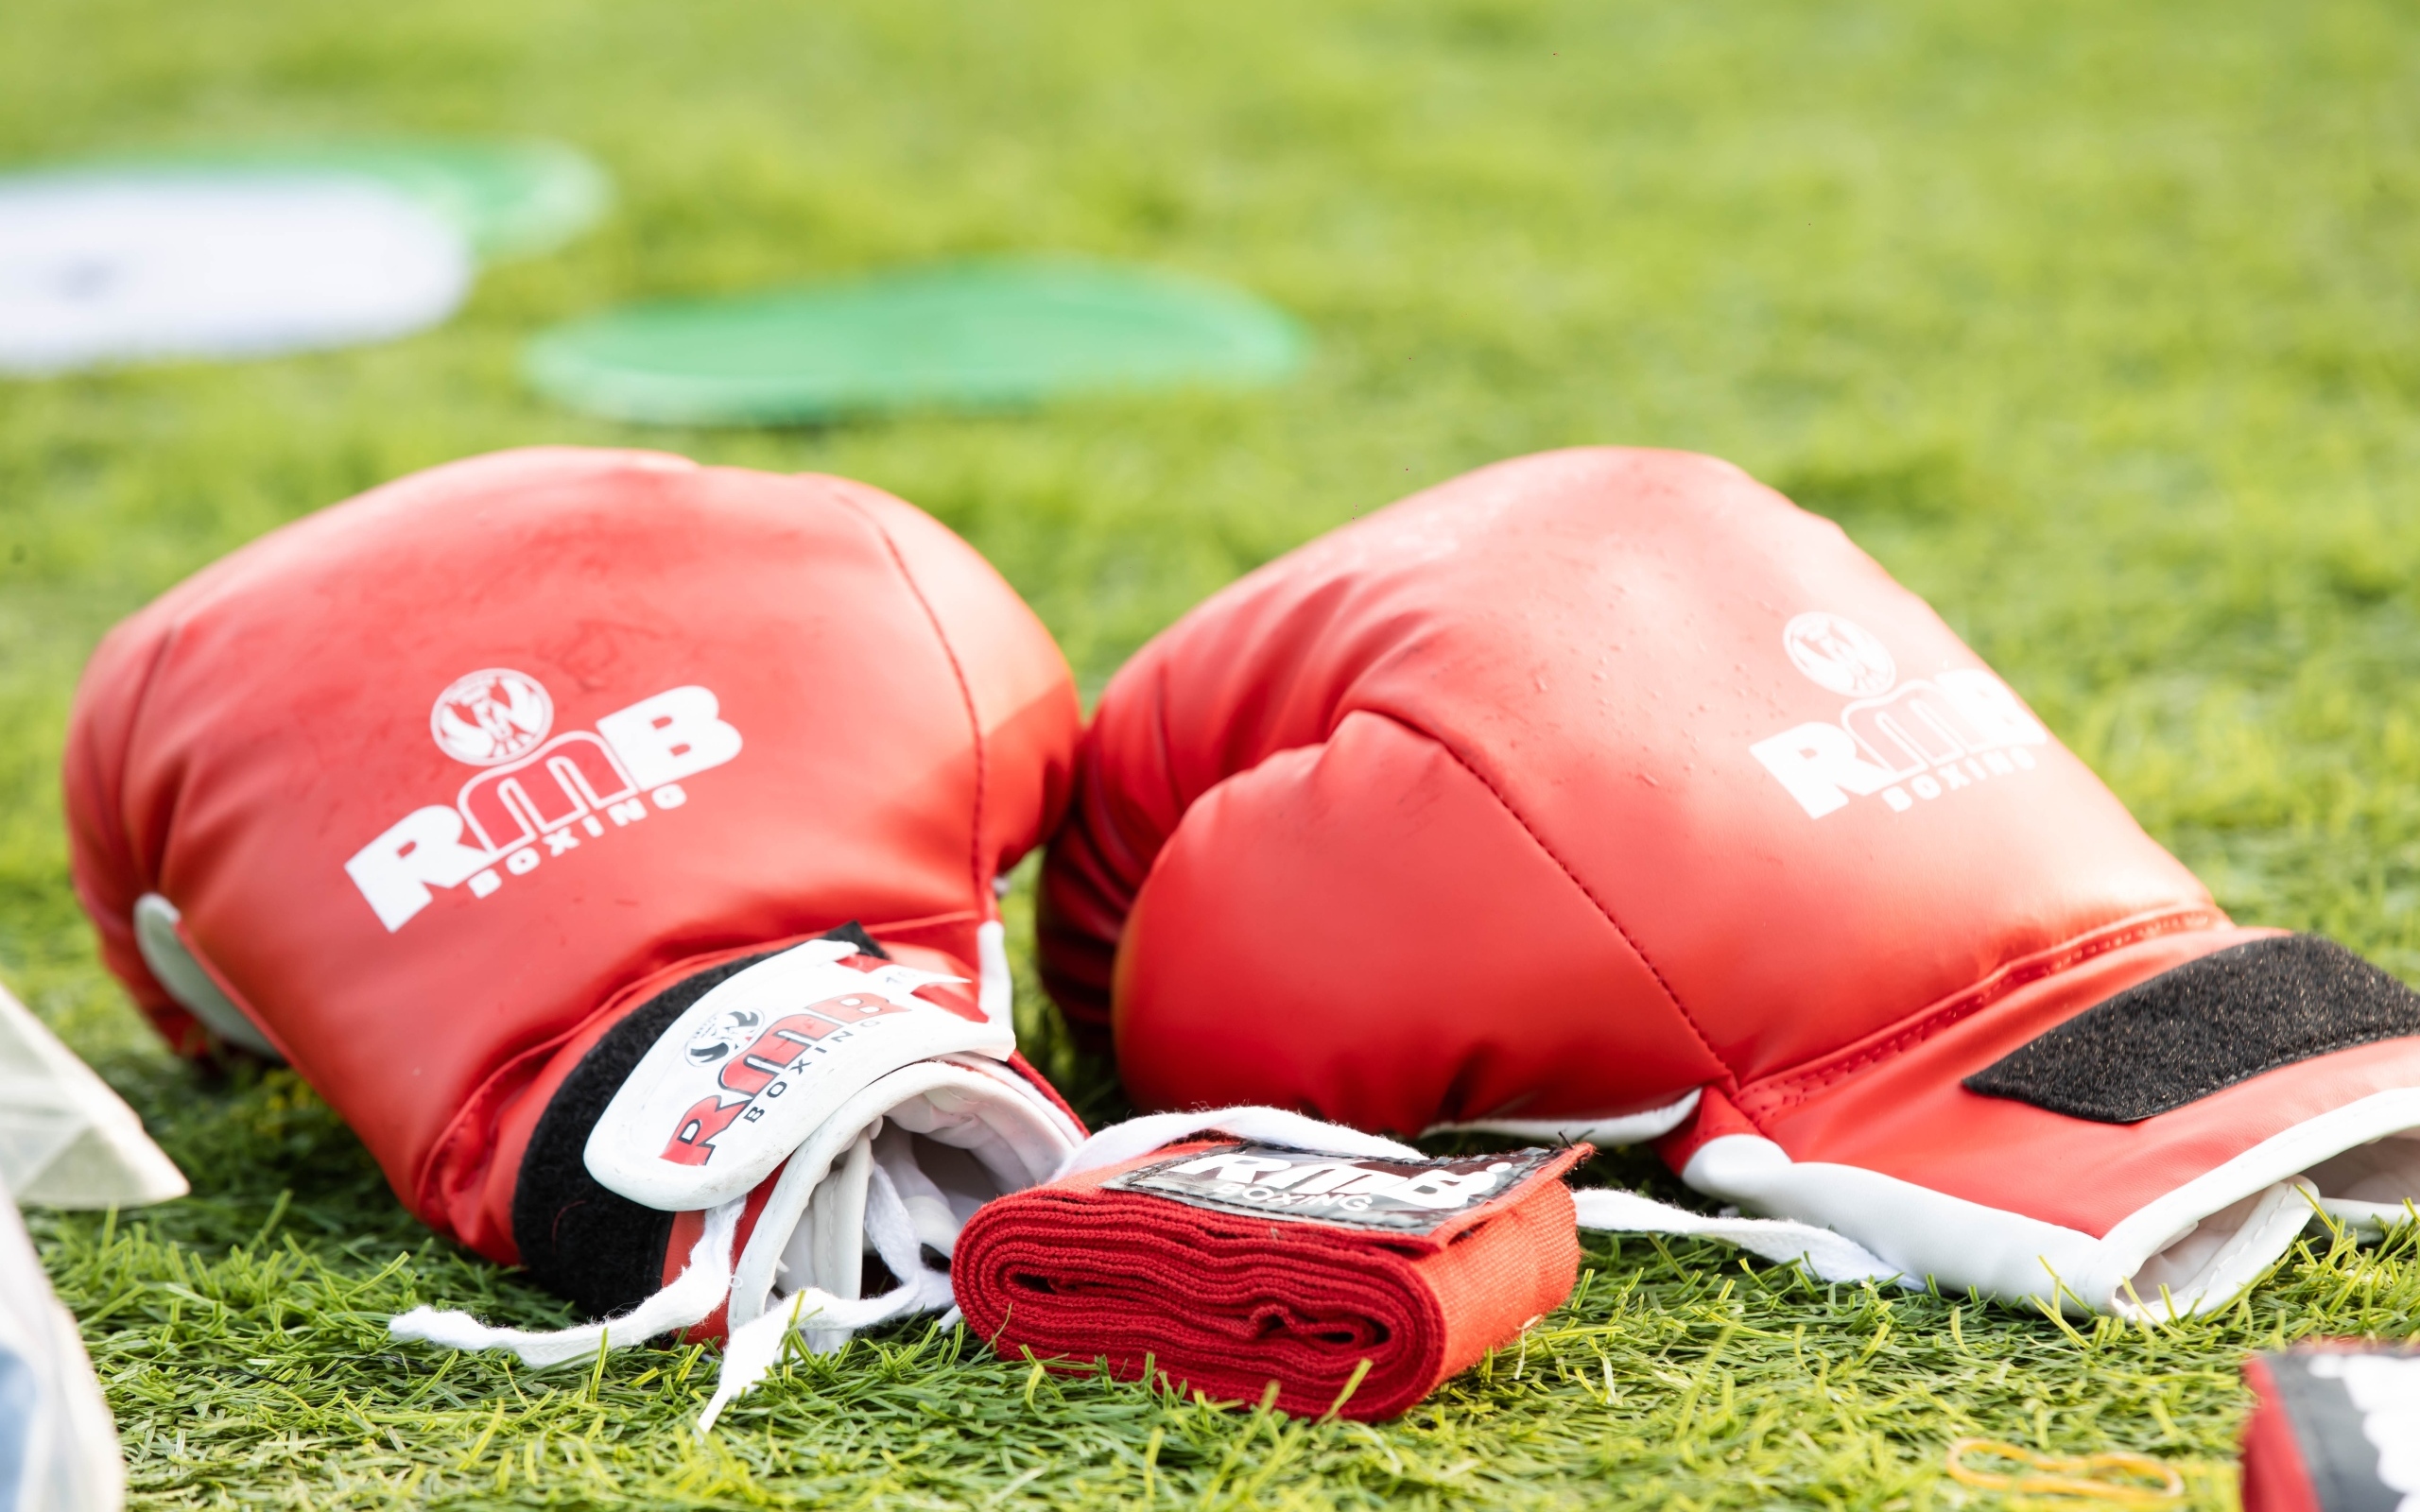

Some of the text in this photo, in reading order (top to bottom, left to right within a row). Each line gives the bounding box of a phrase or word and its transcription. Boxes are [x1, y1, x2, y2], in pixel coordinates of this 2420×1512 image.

[1749, 668, 2047, 820] RMB
[1881, 747, 2036, 813] BOXING
[343, 685, 743, 933] RMB
[468, 782, 686, 899] BOXING
[659, 992, 912, 1166] RMB
[744, 1021, 881, 1123] BOXING
[1167, 1152, 1497, 1209] RMB
[1213, 1182, 1374, 1211] BOXING
